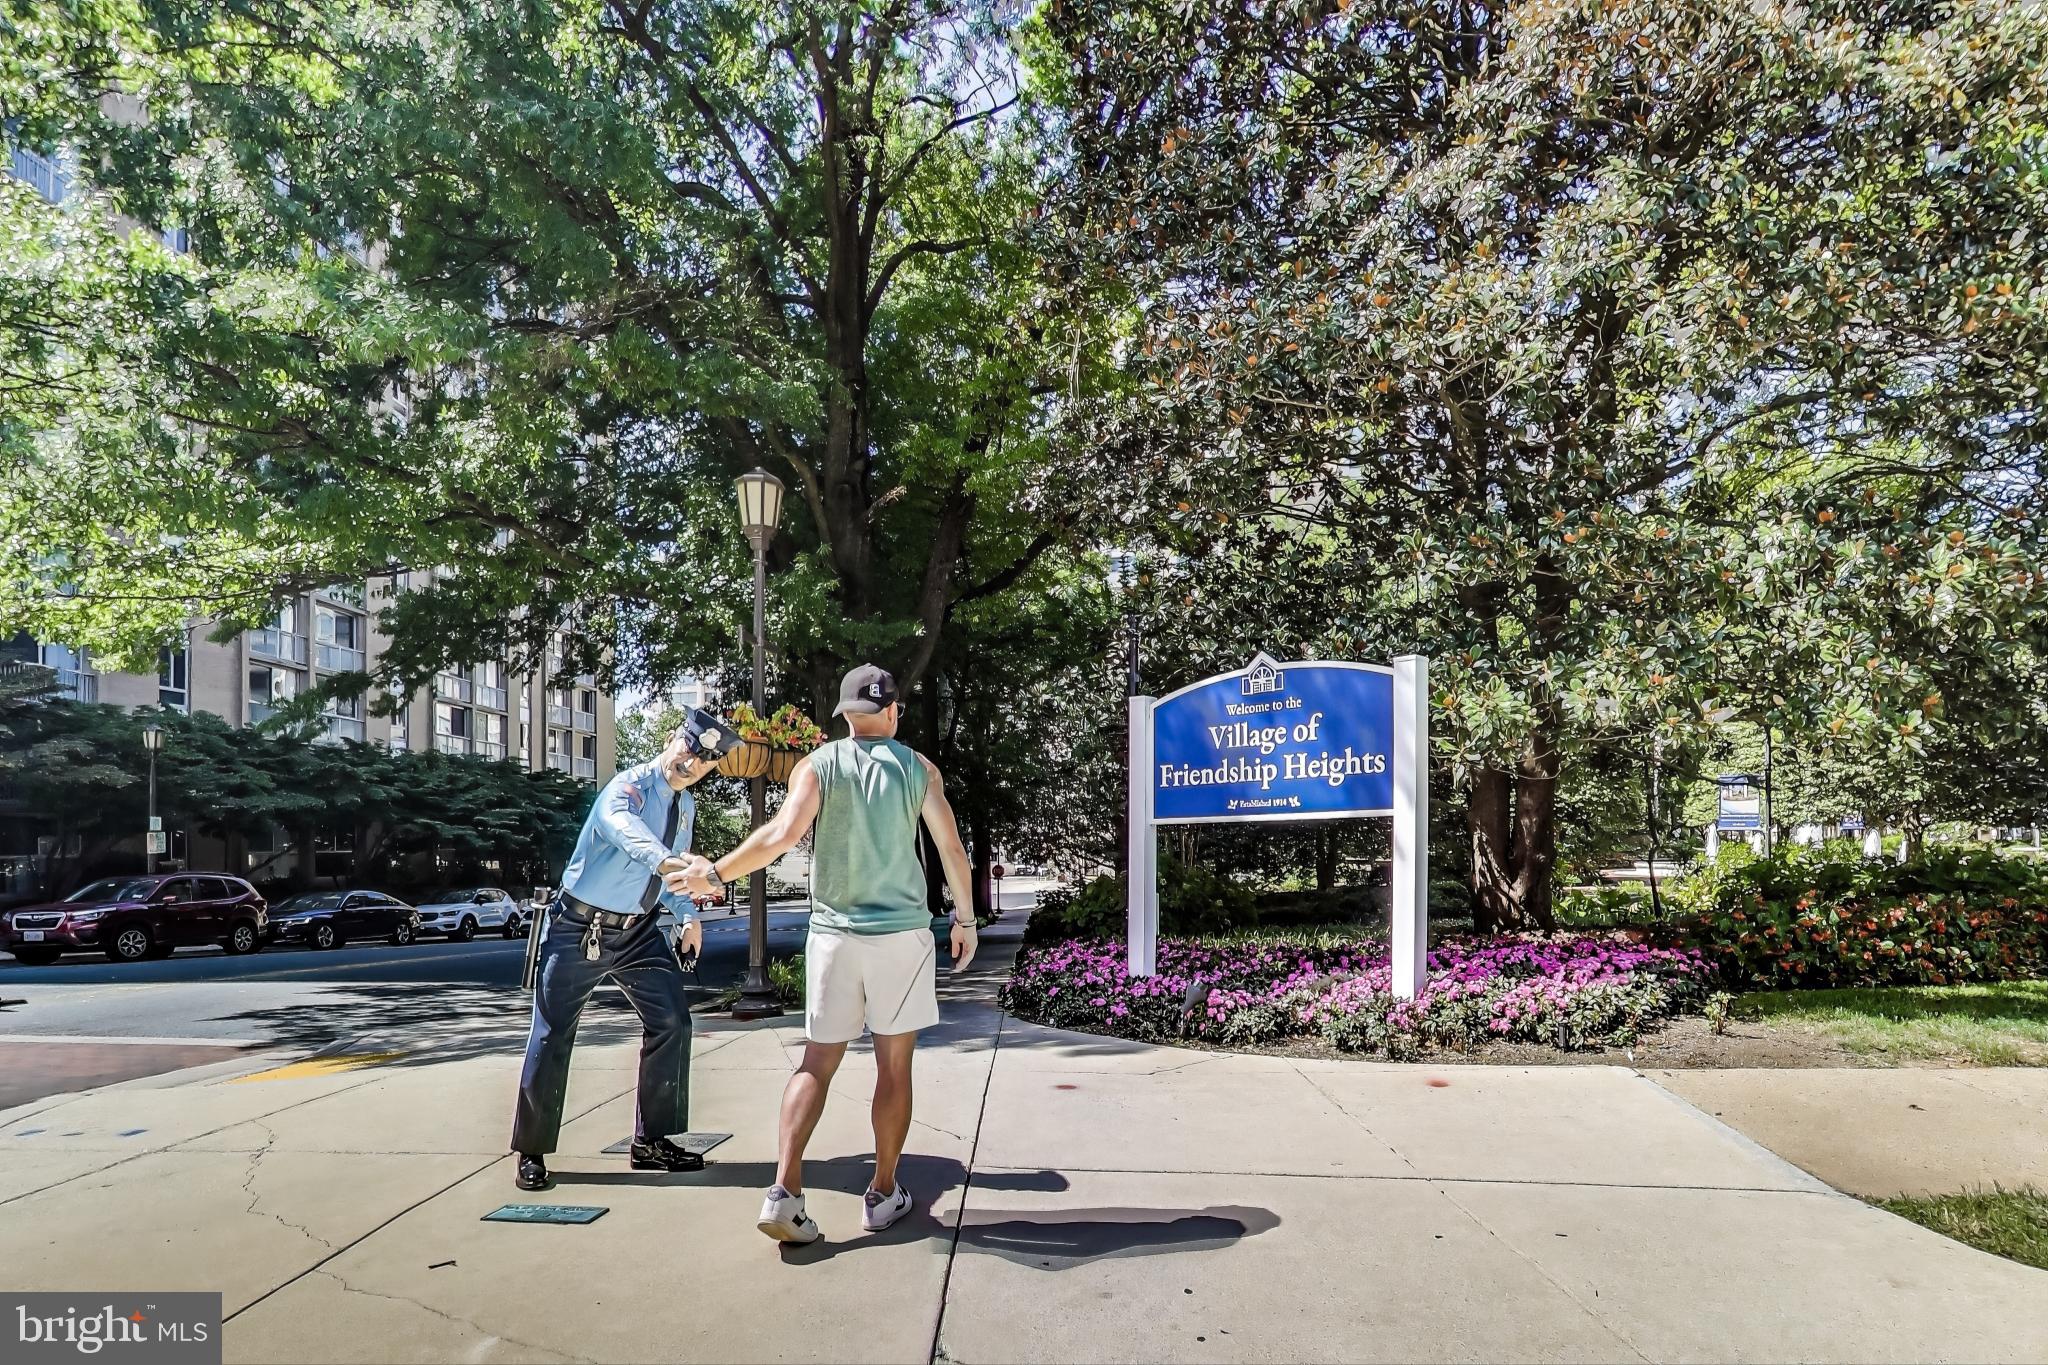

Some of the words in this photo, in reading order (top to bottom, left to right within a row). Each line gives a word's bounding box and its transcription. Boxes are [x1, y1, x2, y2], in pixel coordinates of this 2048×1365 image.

[1226, 703, 1270, 716] Welcome
[1272, 701, 1283, 711] to
[1285, 696, 1302, 709] the
[1208, 721, 1287, 754] Village
[1293, 713, 1323, 743] of
[1159, 757, 1278, 790] Friendship
[1283, 747, 1386, 787] Heights
